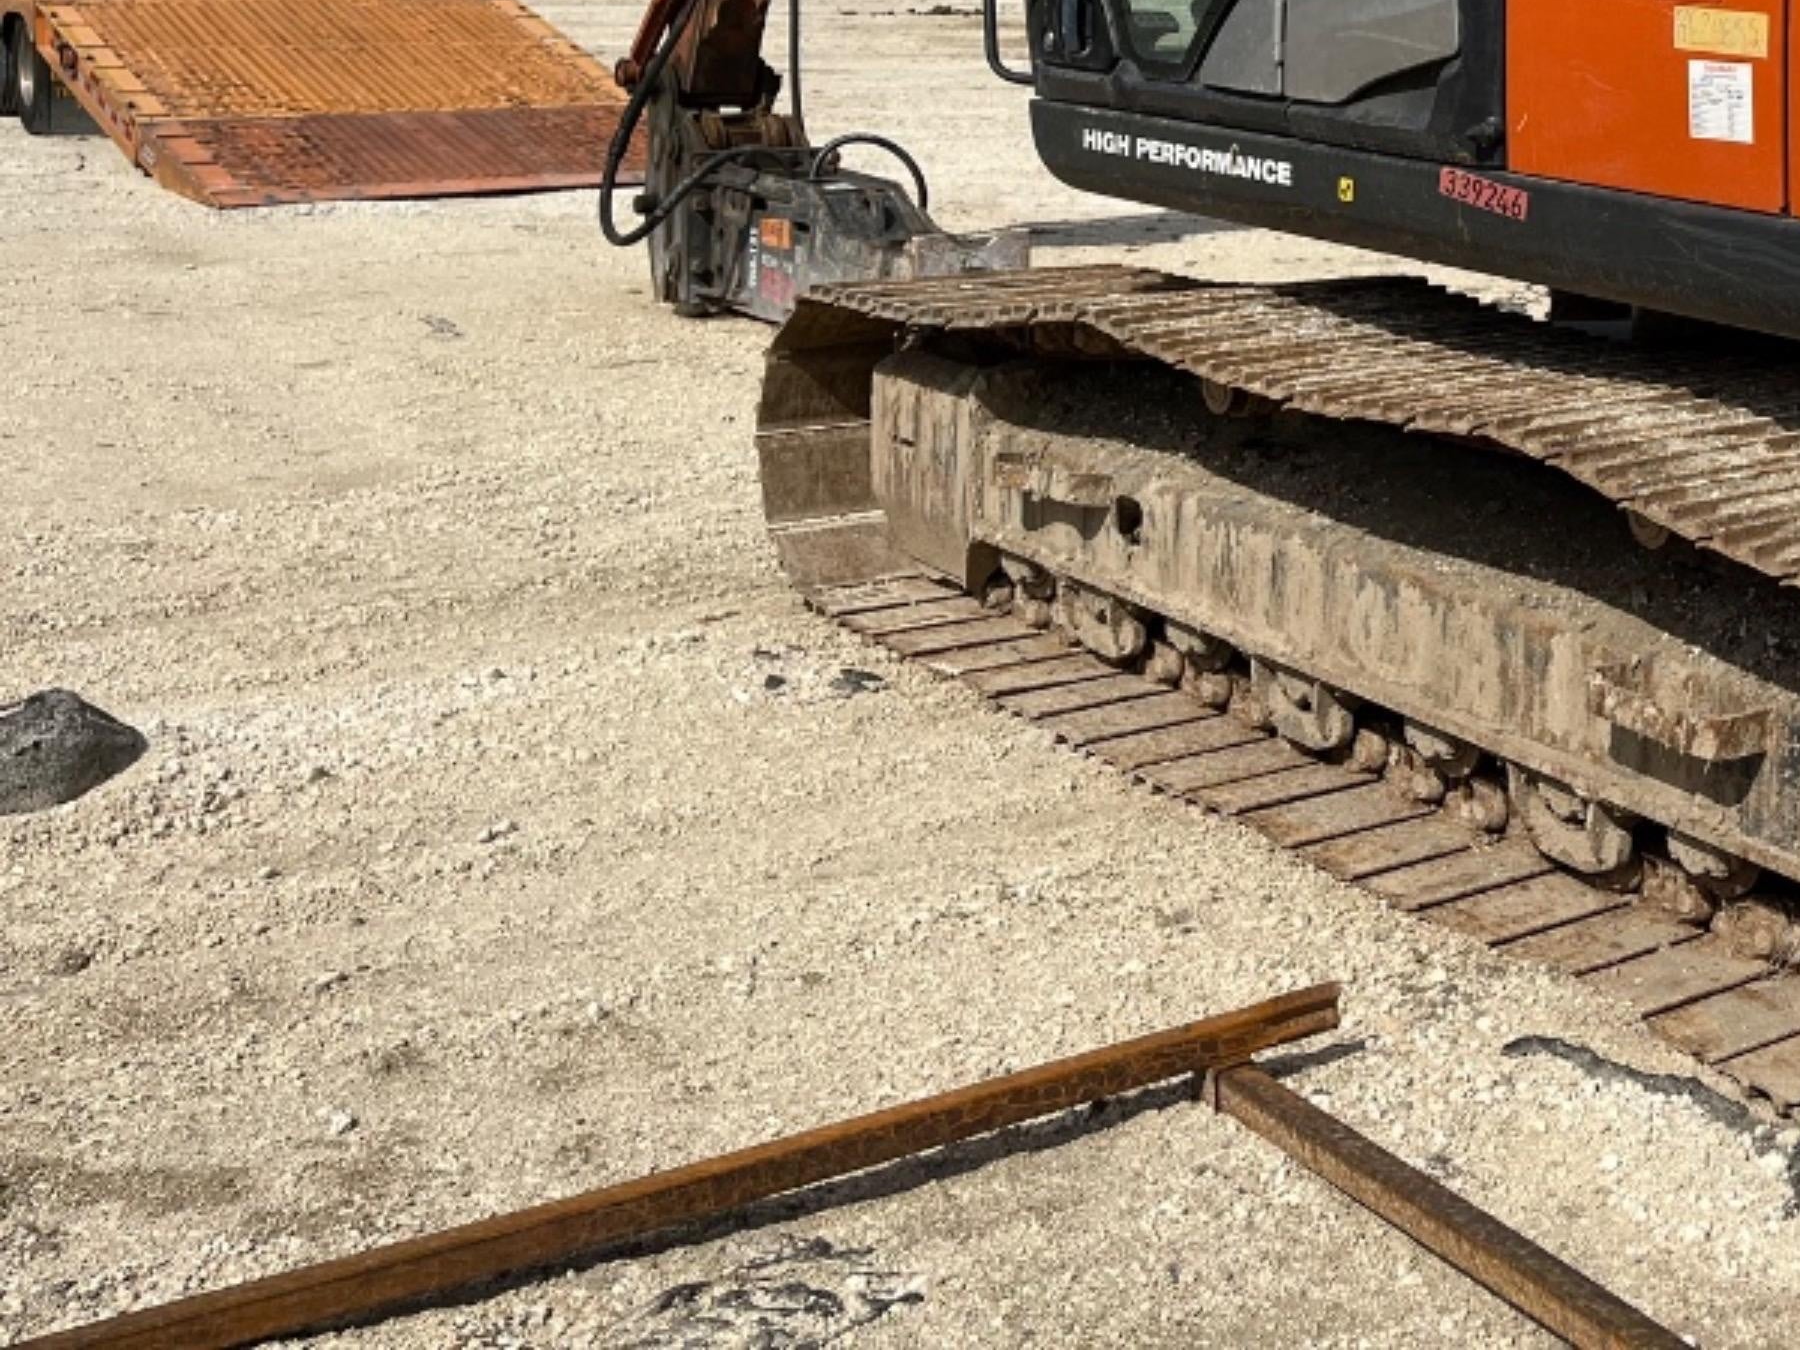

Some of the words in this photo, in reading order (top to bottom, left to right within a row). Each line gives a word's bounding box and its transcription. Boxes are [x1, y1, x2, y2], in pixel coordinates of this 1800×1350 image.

[1082, 128, 1132, 157] HIGH
[1135, 136, 1294, 187] PERFORMANCE
[1443, 169, 1523, 219] 339246
